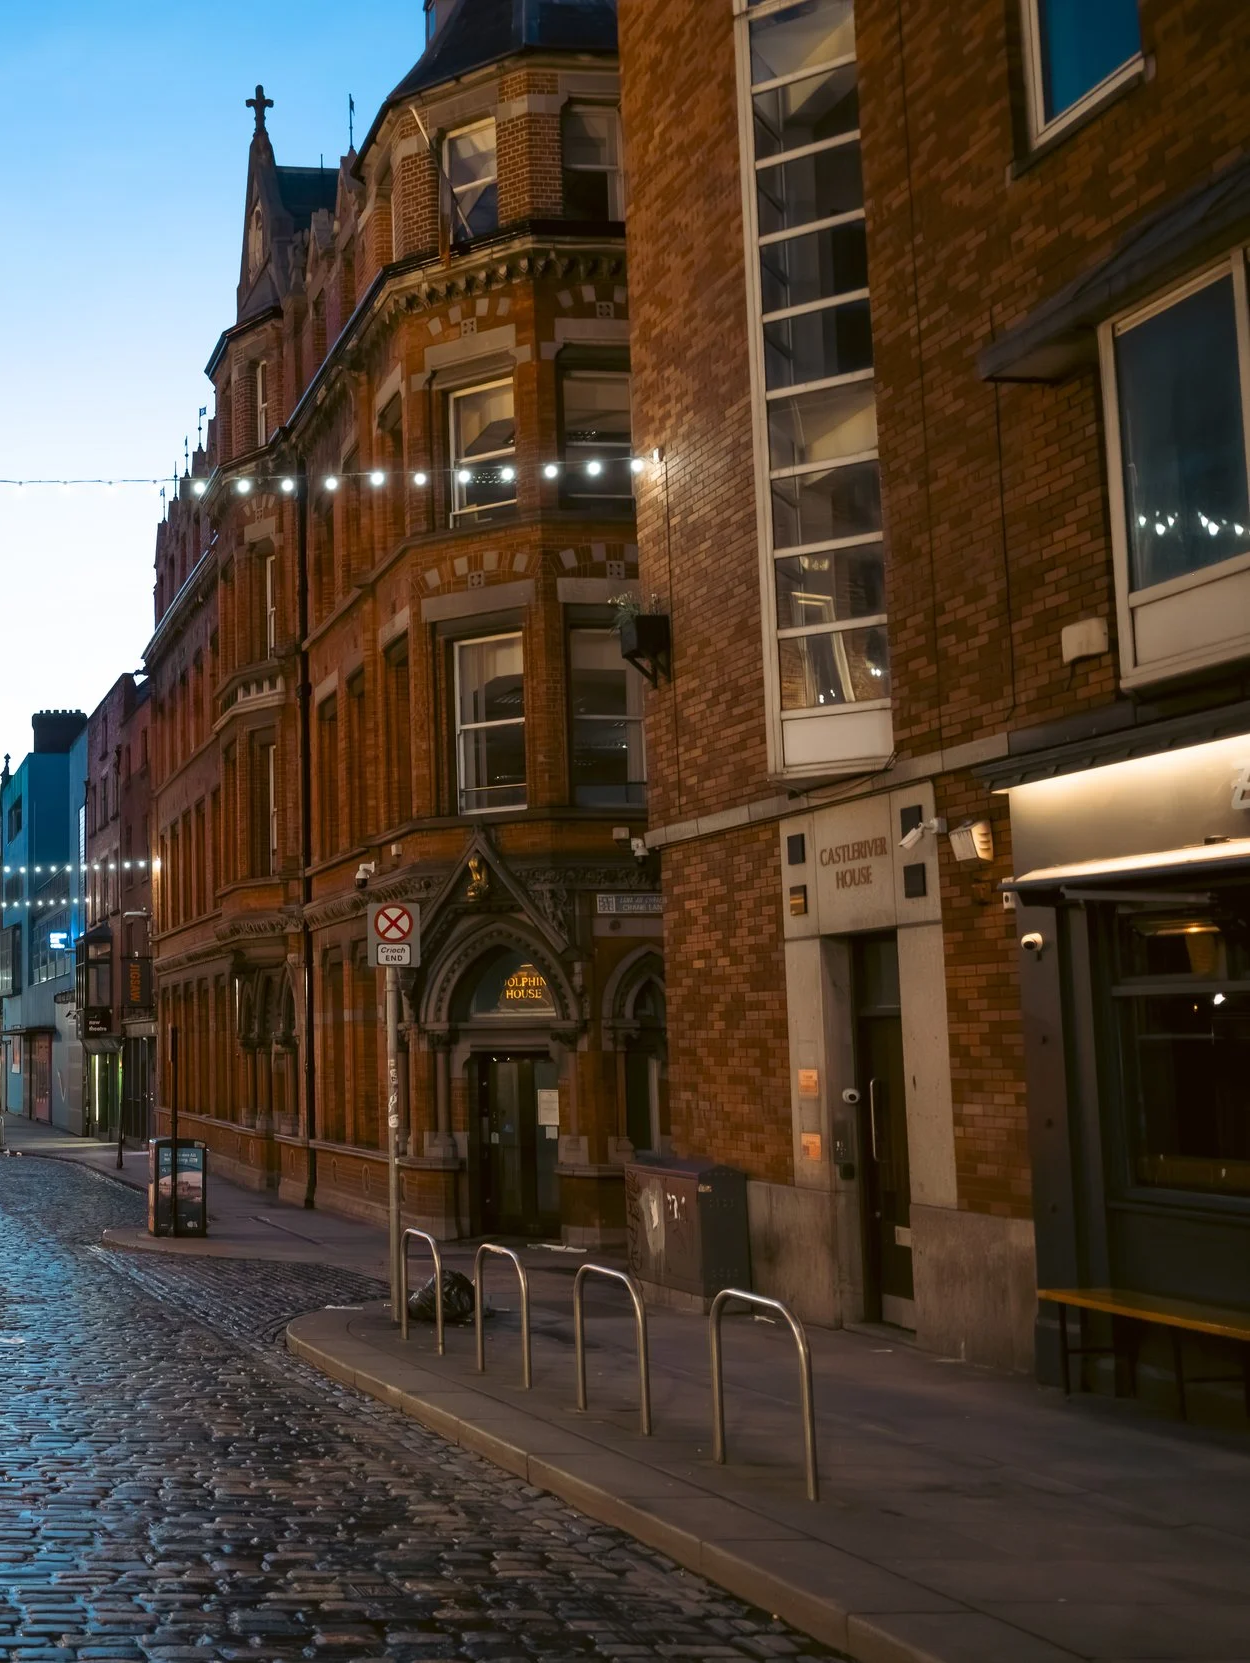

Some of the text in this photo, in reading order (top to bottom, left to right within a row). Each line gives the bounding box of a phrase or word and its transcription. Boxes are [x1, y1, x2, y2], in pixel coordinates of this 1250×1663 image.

[820, 836, 888, 867] CASTLERIVER
[835, 865, 873, 890] HOUSE
[130, 963, 141, 1002] JIGSAW
[504, 976, 547, 987] OLPHIN
[505, 988, 542, 999] HOUSE
